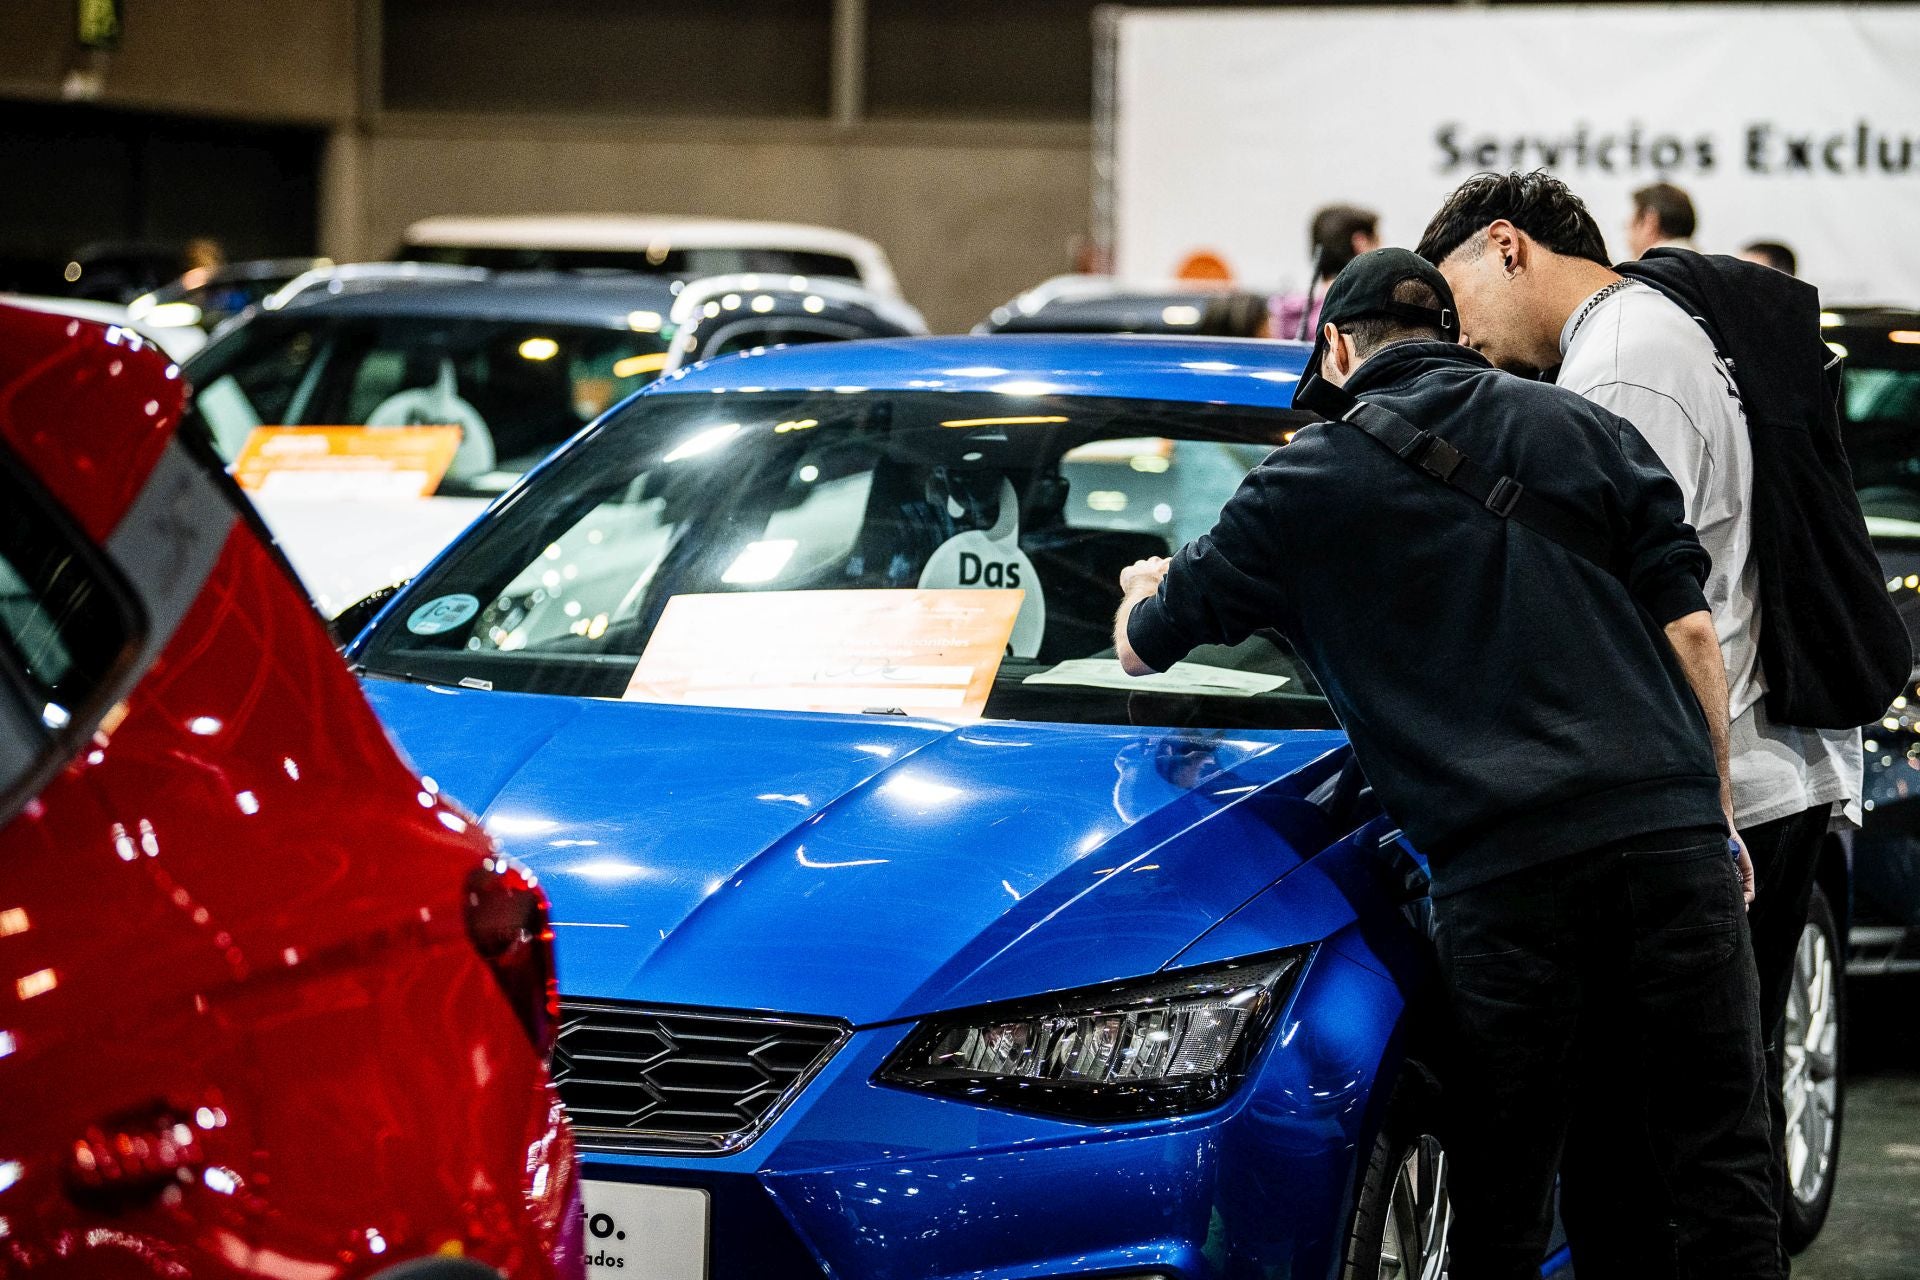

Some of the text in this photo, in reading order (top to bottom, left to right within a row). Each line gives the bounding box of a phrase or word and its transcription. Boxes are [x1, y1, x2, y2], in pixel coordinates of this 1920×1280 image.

[1434, 120, 1920, 175] Servicios Exclu
[959, 551, 1021, 589] Das
